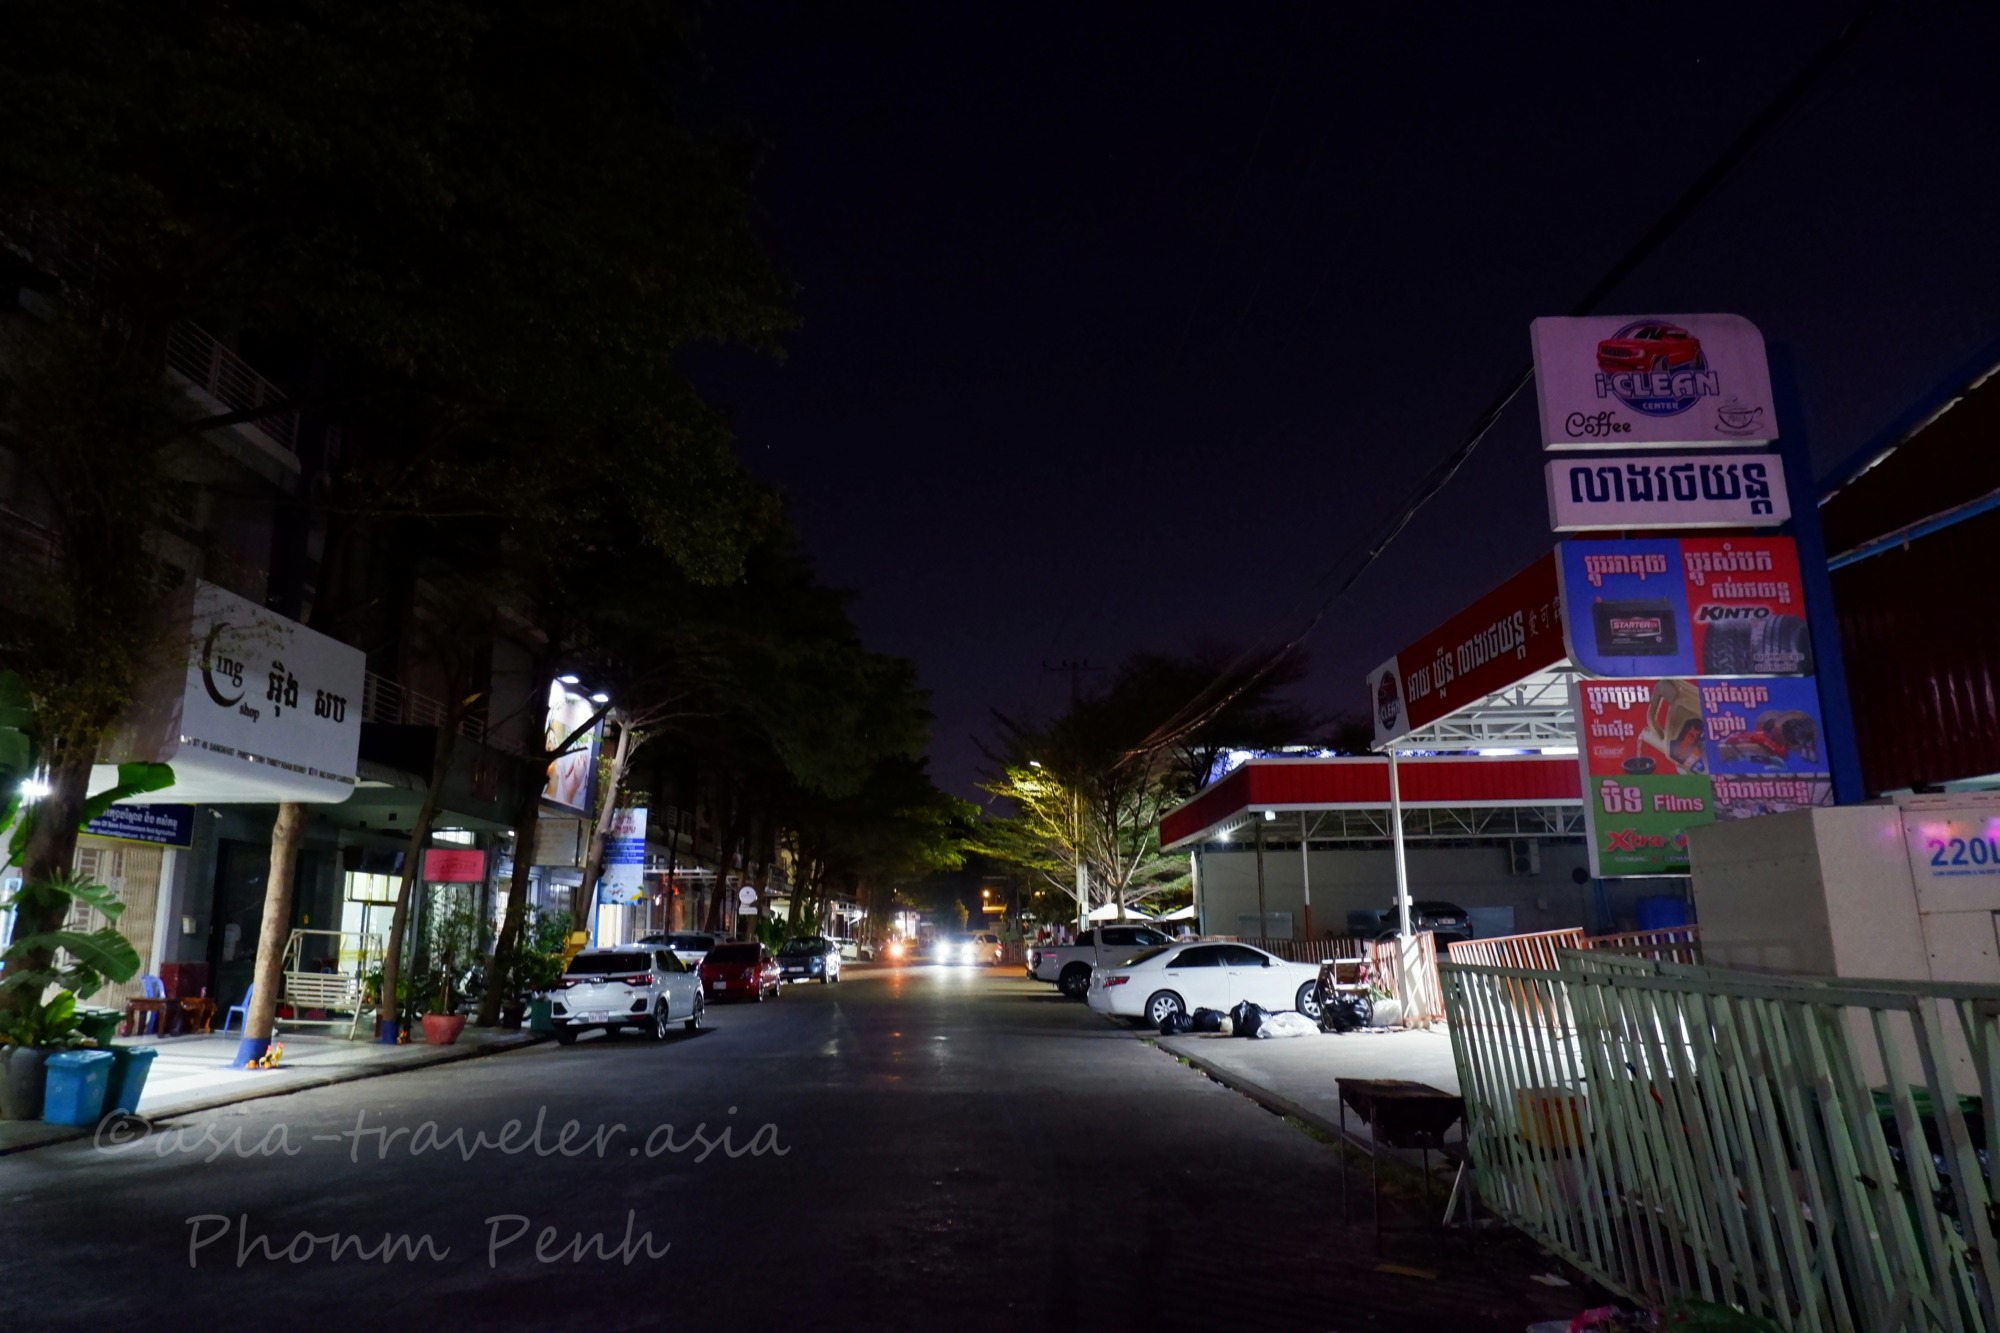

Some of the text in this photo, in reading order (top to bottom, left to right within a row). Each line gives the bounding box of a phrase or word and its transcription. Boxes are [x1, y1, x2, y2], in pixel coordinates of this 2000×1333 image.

[1643, 402, 1679, 410] CENTER
[1565, 412, 1632, 437] Coffee
[1699, 606, 1769, 621] KINTO
[239, 702, 260, 723] shop
[1653, 794, 1704, 812] Films
